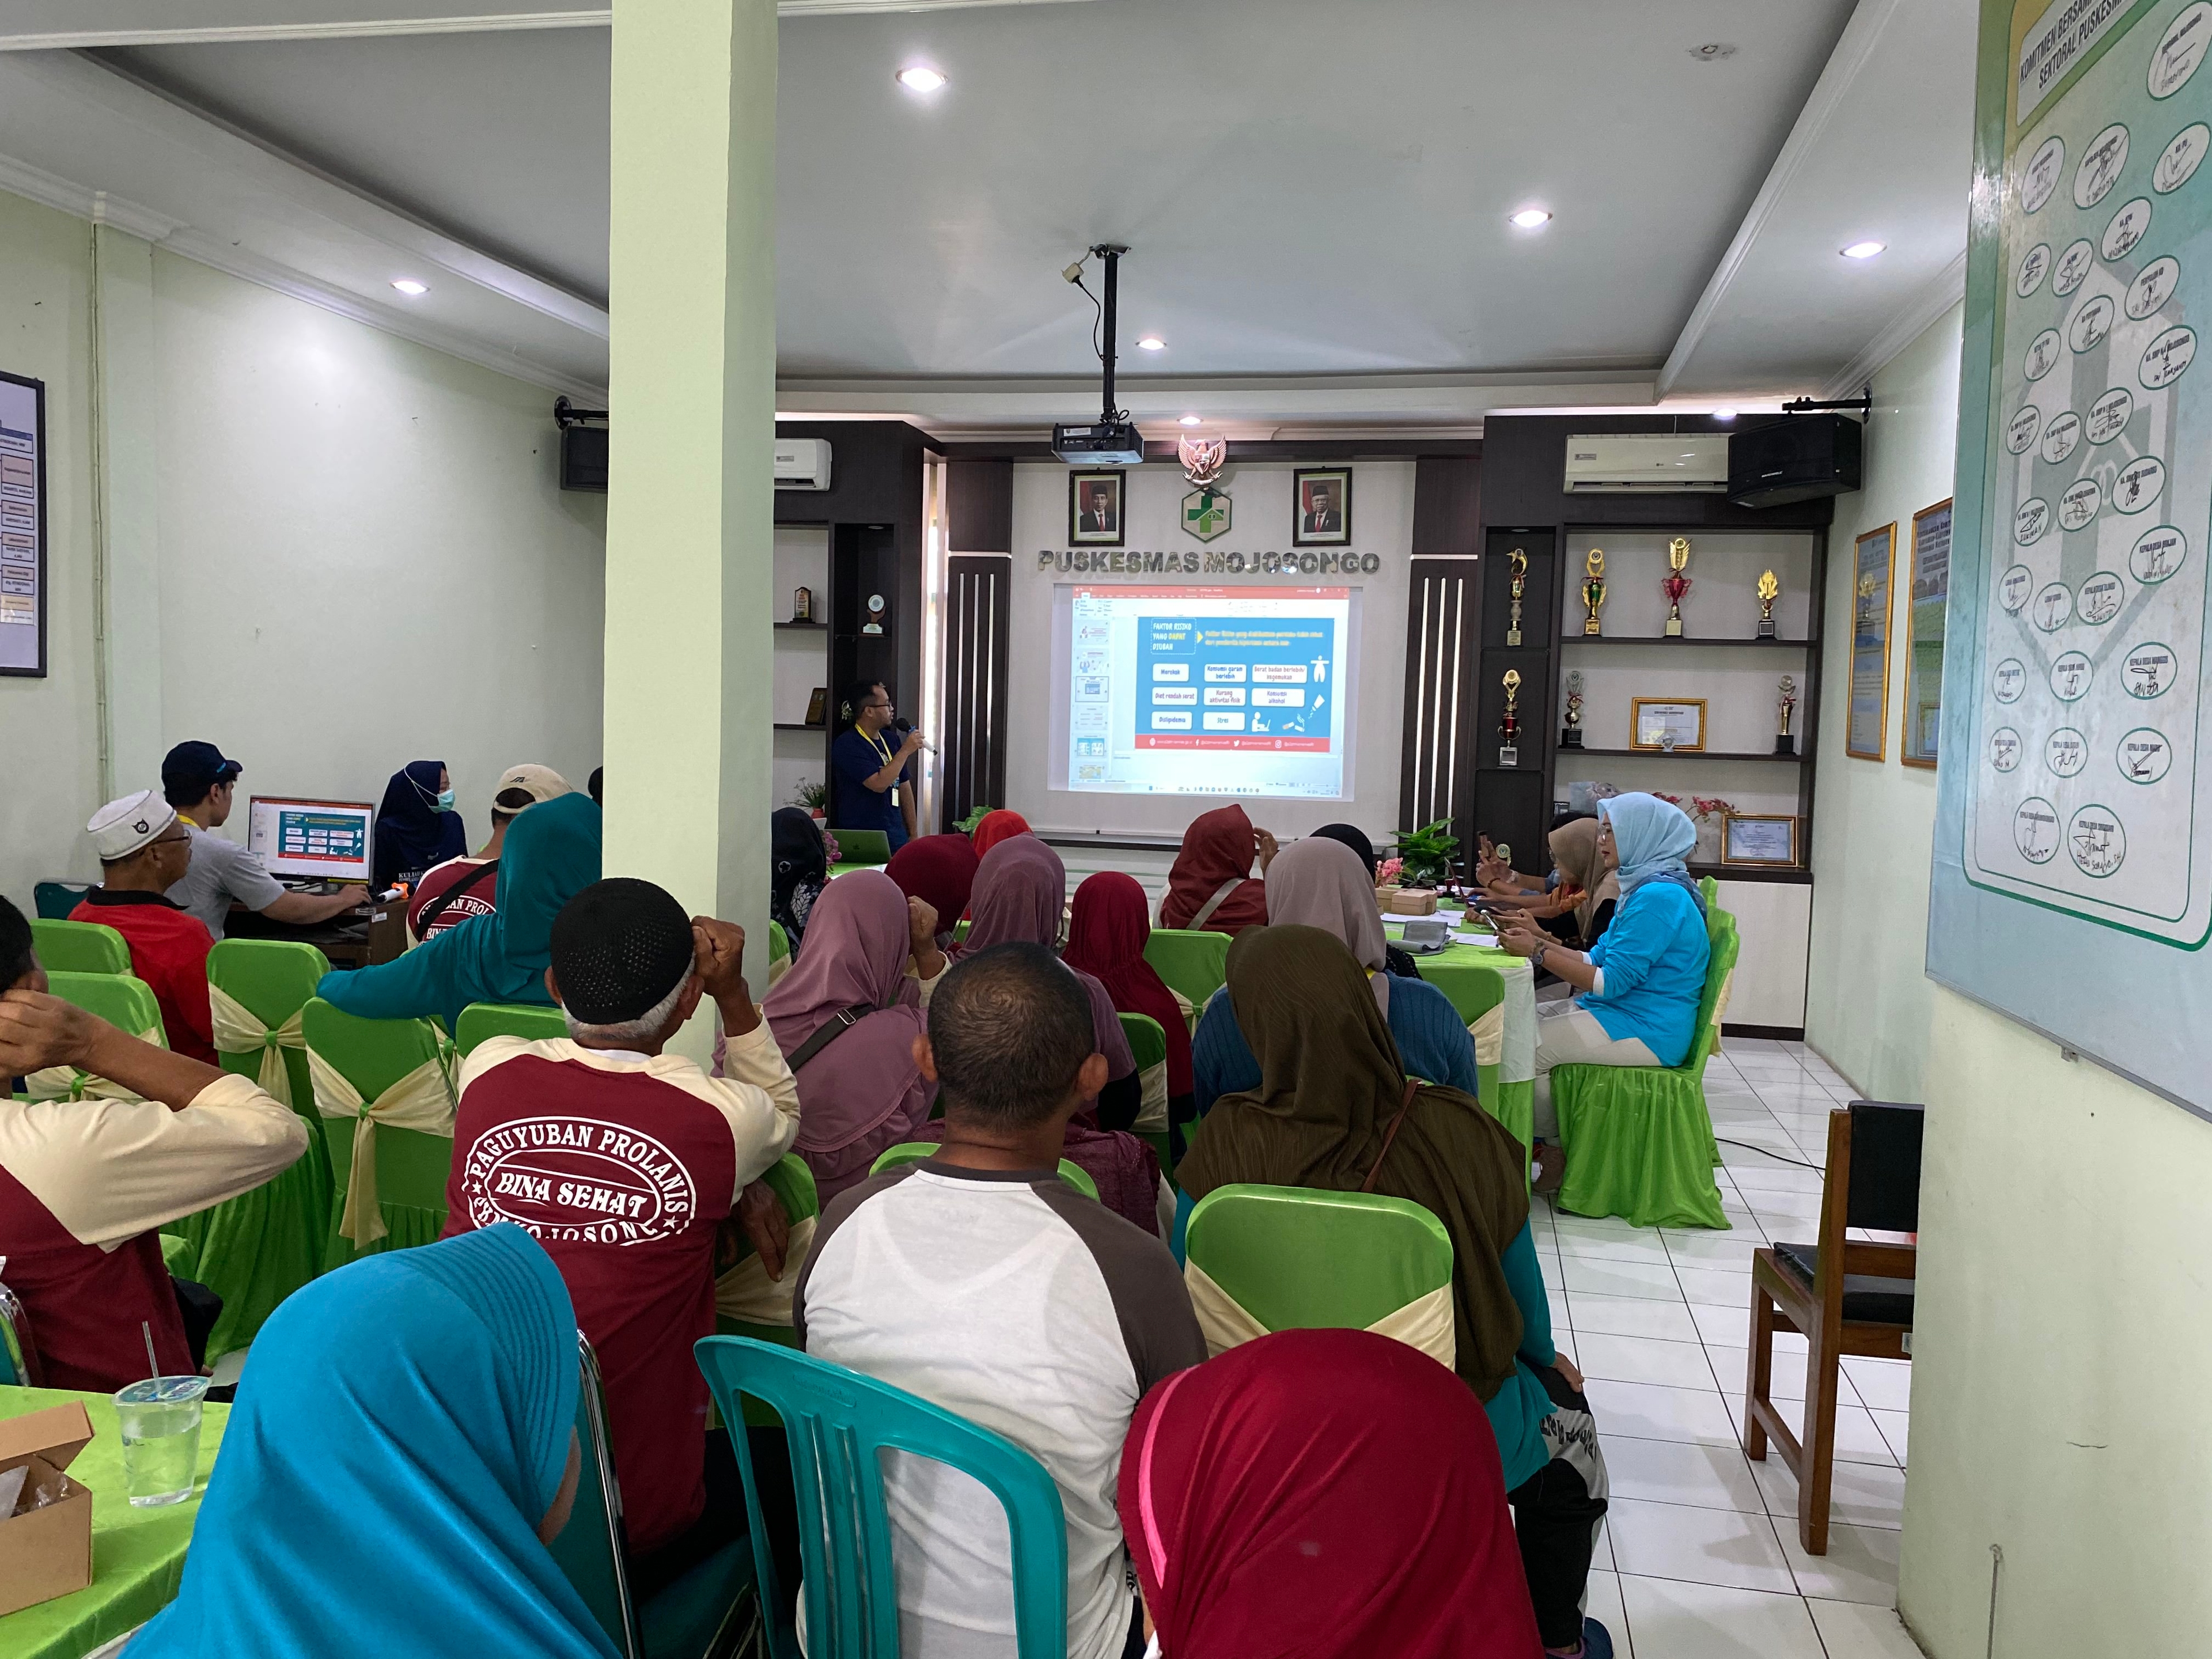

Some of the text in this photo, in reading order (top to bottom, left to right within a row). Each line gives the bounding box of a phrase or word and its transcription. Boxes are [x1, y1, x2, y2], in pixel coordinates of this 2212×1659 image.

[2020, 0, 2092, 84] KOMITMEN BERSAM
[2039, 33, 2076, 89] SEKTORAL
[2078, 0, 2122, 46] PUSKESM
[1038, 551, 1380, 574] PUSKESMAS MOJOSONGO
[1153, 632, 1167, 641] YANG
[1173, 623, 1192, 631] RISIKO
[1228, 666, 1243, 675] garam
[1216, 690, 1233, 698] Kurang
[469, 1124, 688, 1215] PAGUYUBAN PROLANIS
[495, 1172, 648, 1218] BINA SEHAT
